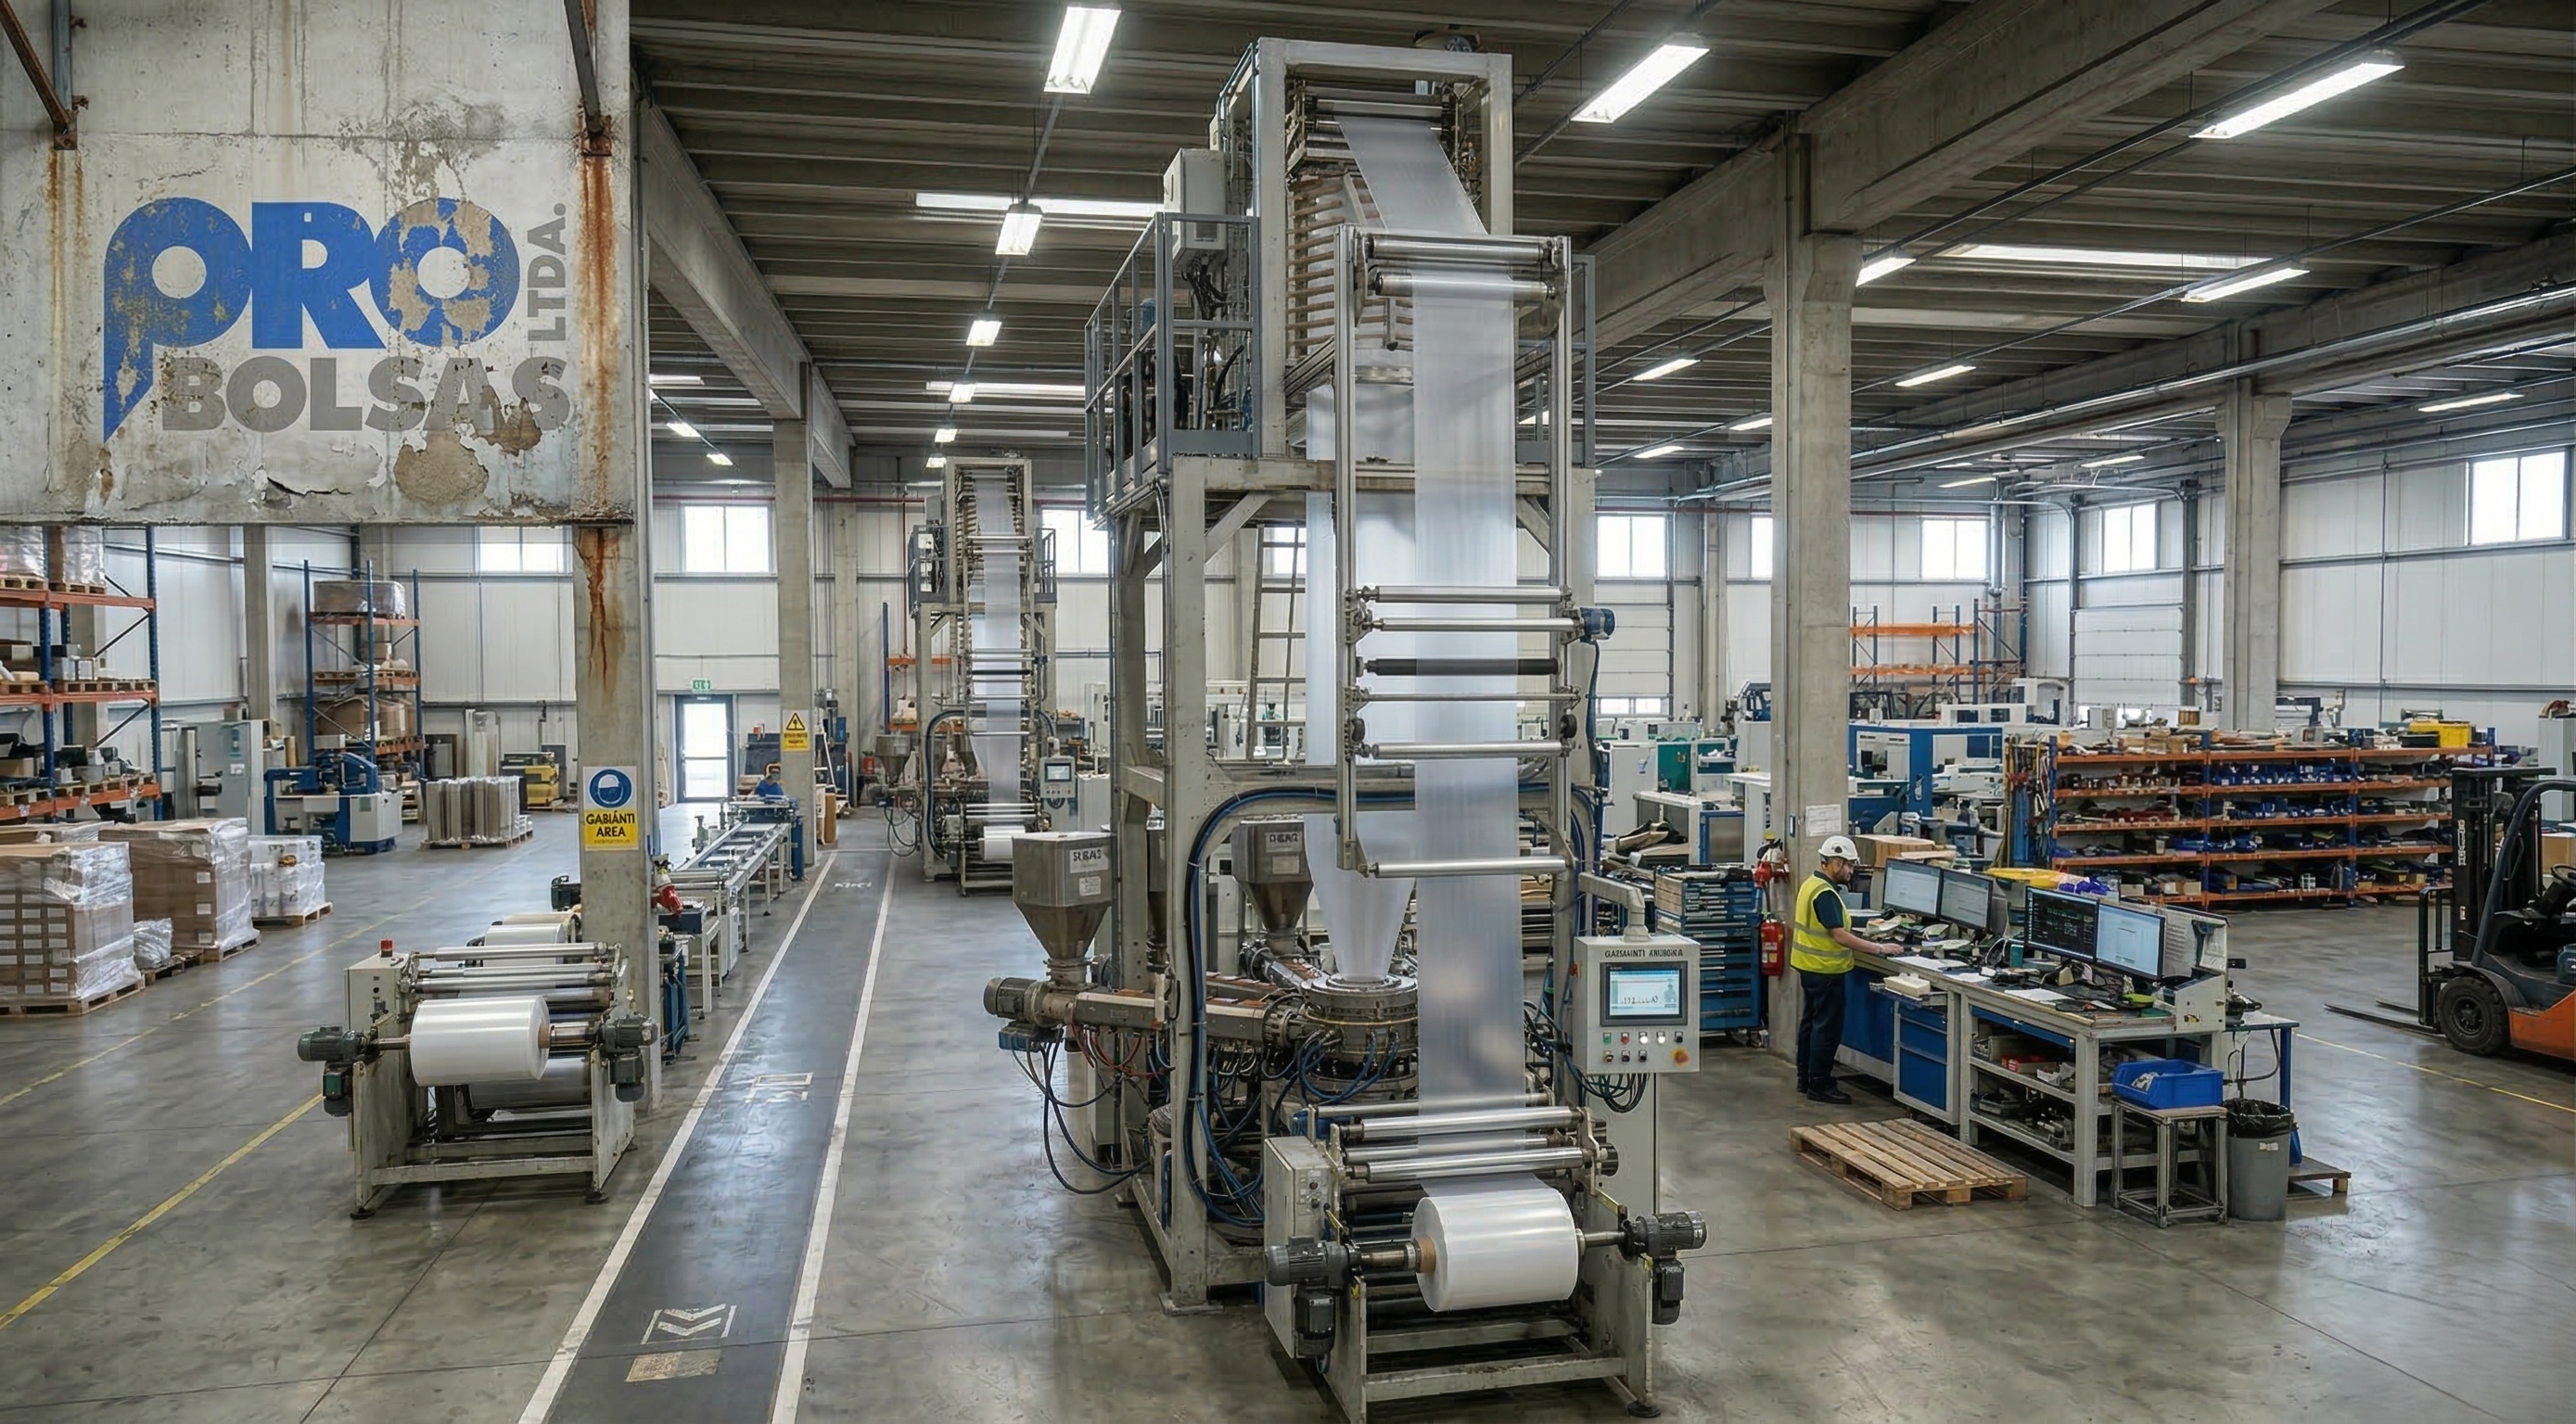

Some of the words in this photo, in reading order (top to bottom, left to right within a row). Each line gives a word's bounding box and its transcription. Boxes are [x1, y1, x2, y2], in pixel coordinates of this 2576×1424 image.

[527, 202, 567, 341] LTDA.
[162, 356, 572, 433] BOLSAS
[596, 826, 627, 837] AREA
